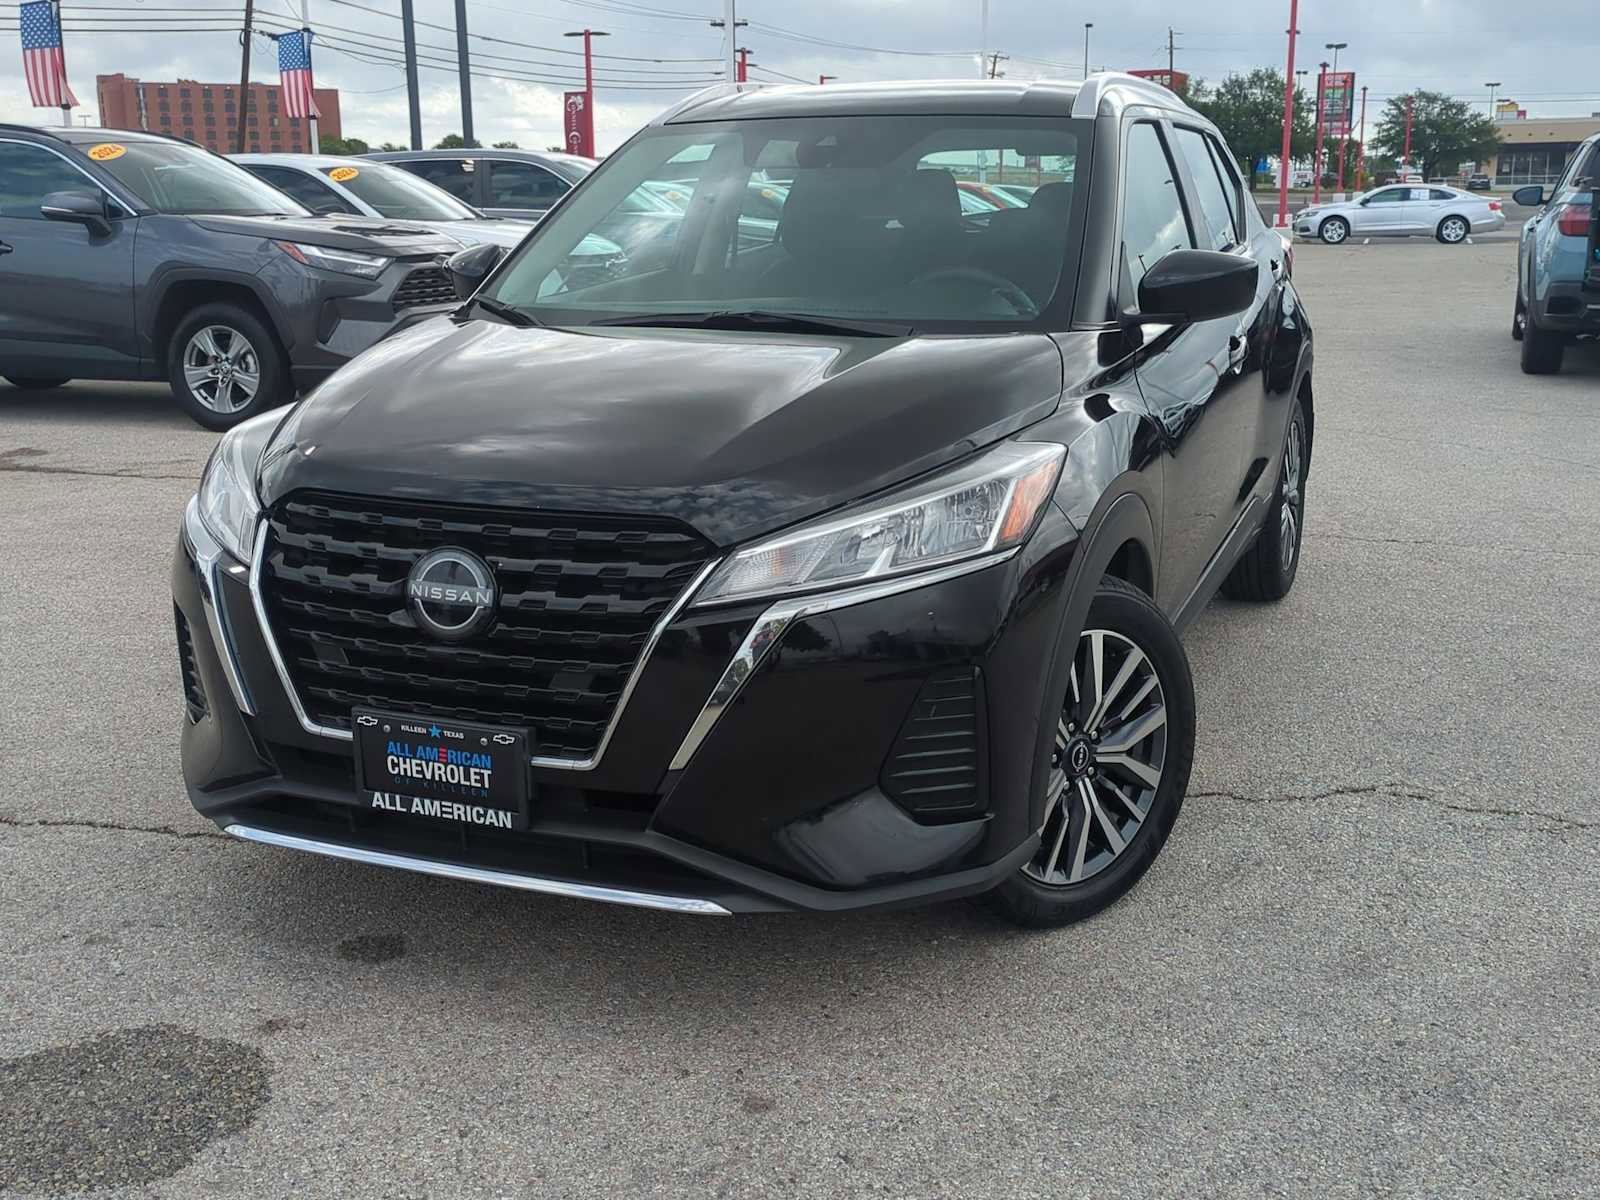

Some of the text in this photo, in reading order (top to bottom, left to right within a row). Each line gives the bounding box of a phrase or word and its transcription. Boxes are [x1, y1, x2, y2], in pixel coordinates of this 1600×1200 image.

[411, 583, 490, 604] NISSAN
[401, 725, 465, 740] KILLEEN TEXAS
[386, 741, 492, 768] ALL AMERICAN
[386, 755, 492, 789] CHEVROLET
[371, 791, 513, 829] ALL AMERICAN
